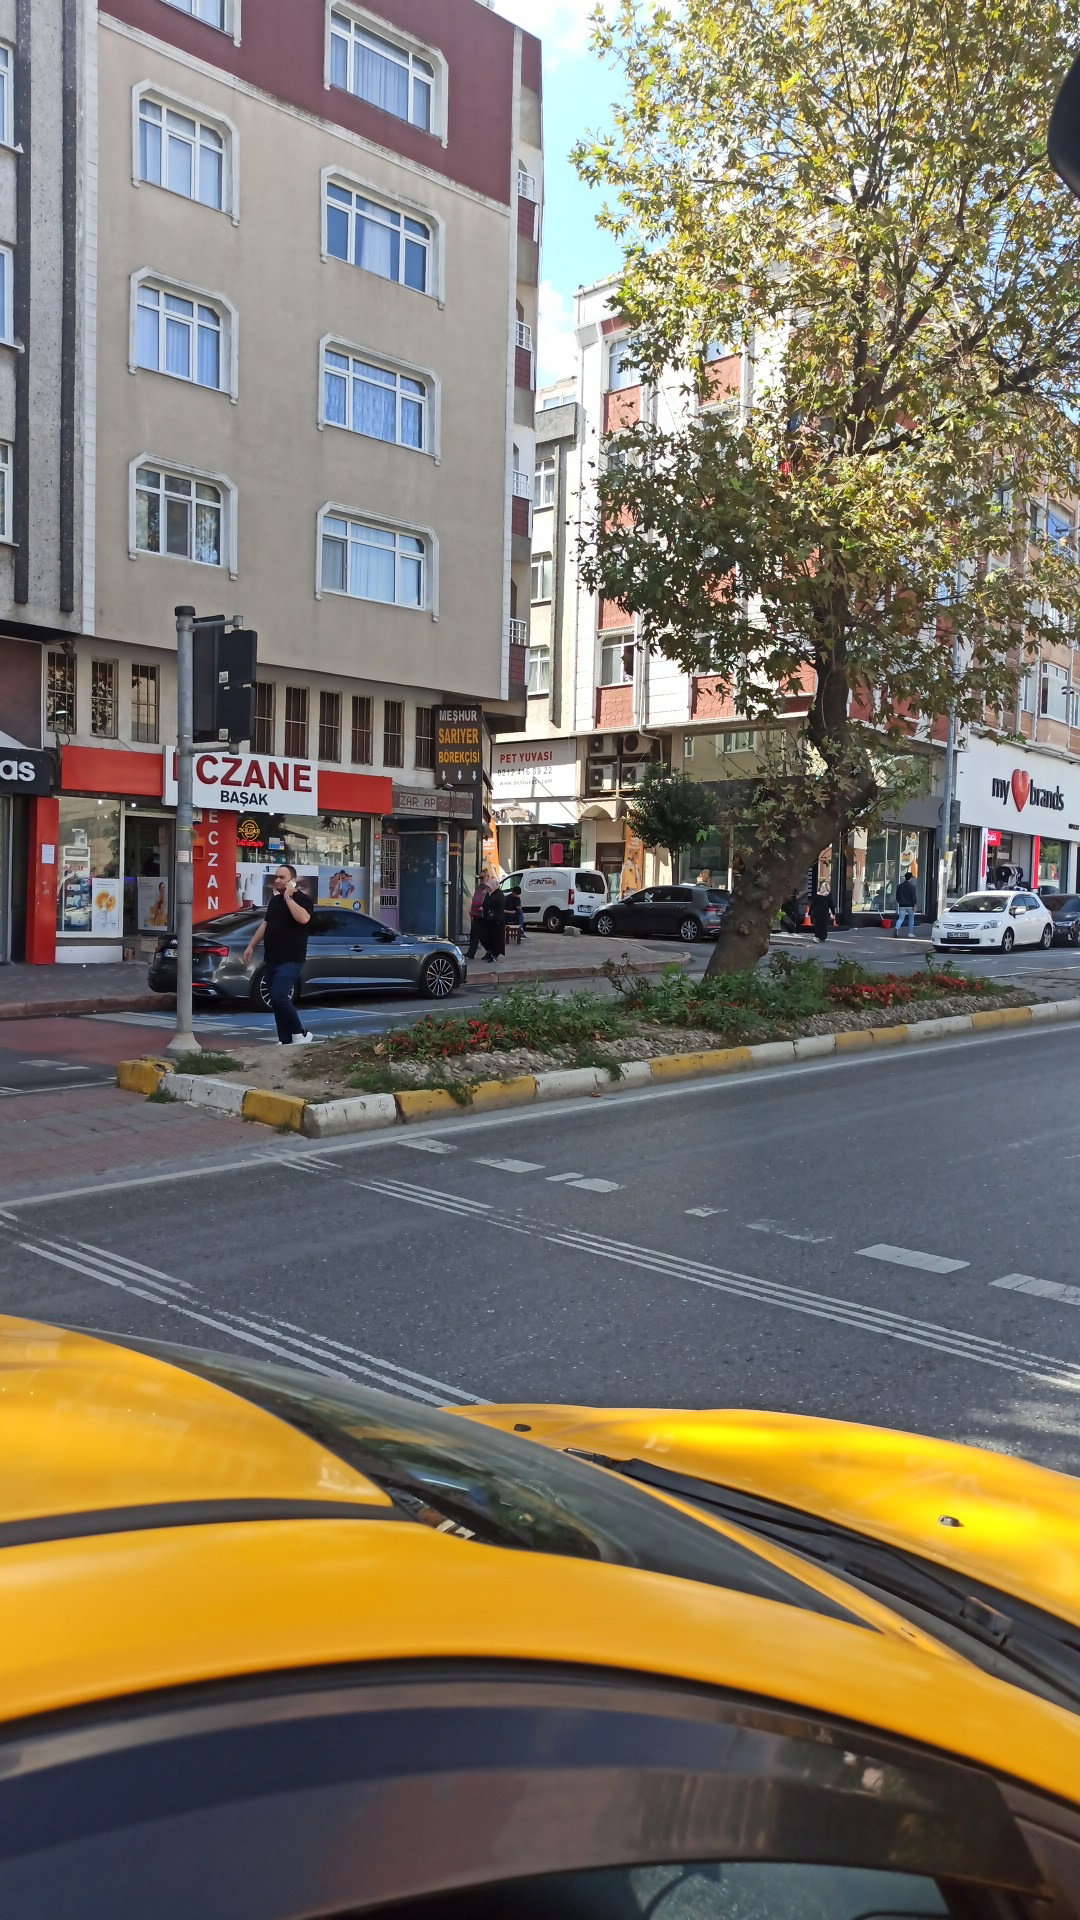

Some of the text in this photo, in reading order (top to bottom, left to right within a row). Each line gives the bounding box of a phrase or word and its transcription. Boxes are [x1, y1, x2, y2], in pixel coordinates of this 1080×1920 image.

[439, 710, 477, 724] MEŞHUR
[438, 728, 479, 744] SARIYER
[438, 749, 480, 766] BÖREKÇİSİ
[500, 751, 553, 763] PET YUVASI
[173, 752, 312, 792] CZANE
[497, 768, 515, 777] 0212
[543, 766, 553, 774] 22
[220, 790, 268, 806] BAŞAK
[992, 777, 1064, 811] my brands
